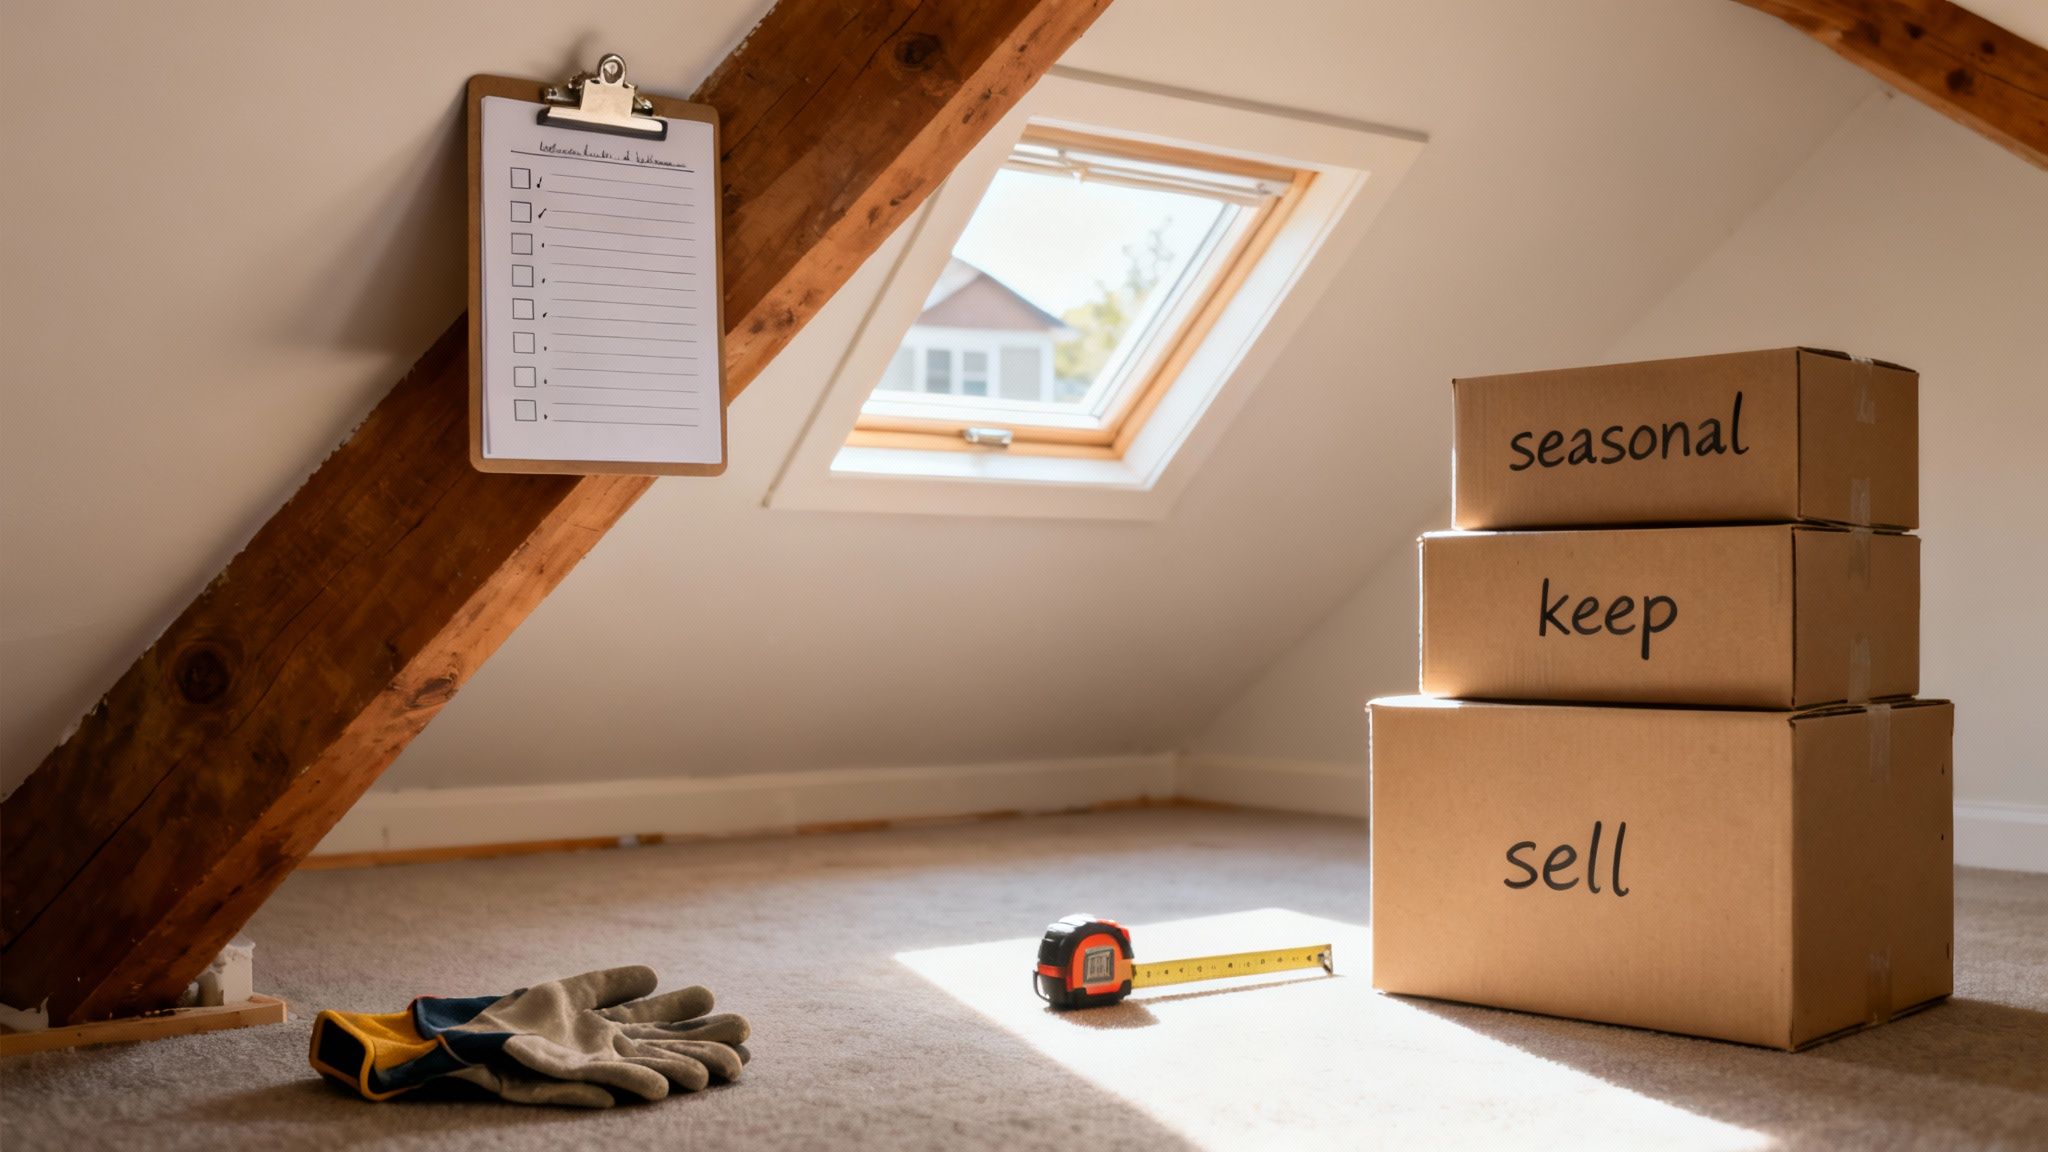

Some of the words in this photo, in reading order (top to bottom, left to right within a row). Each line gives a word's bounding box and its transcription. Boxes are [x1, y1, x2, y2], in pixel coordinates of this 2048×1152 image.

[1509, 391, 1750, 471] seasonal
[1538, 577, 1678, 661] keep
[1503, 820, 1629, 898] sell
